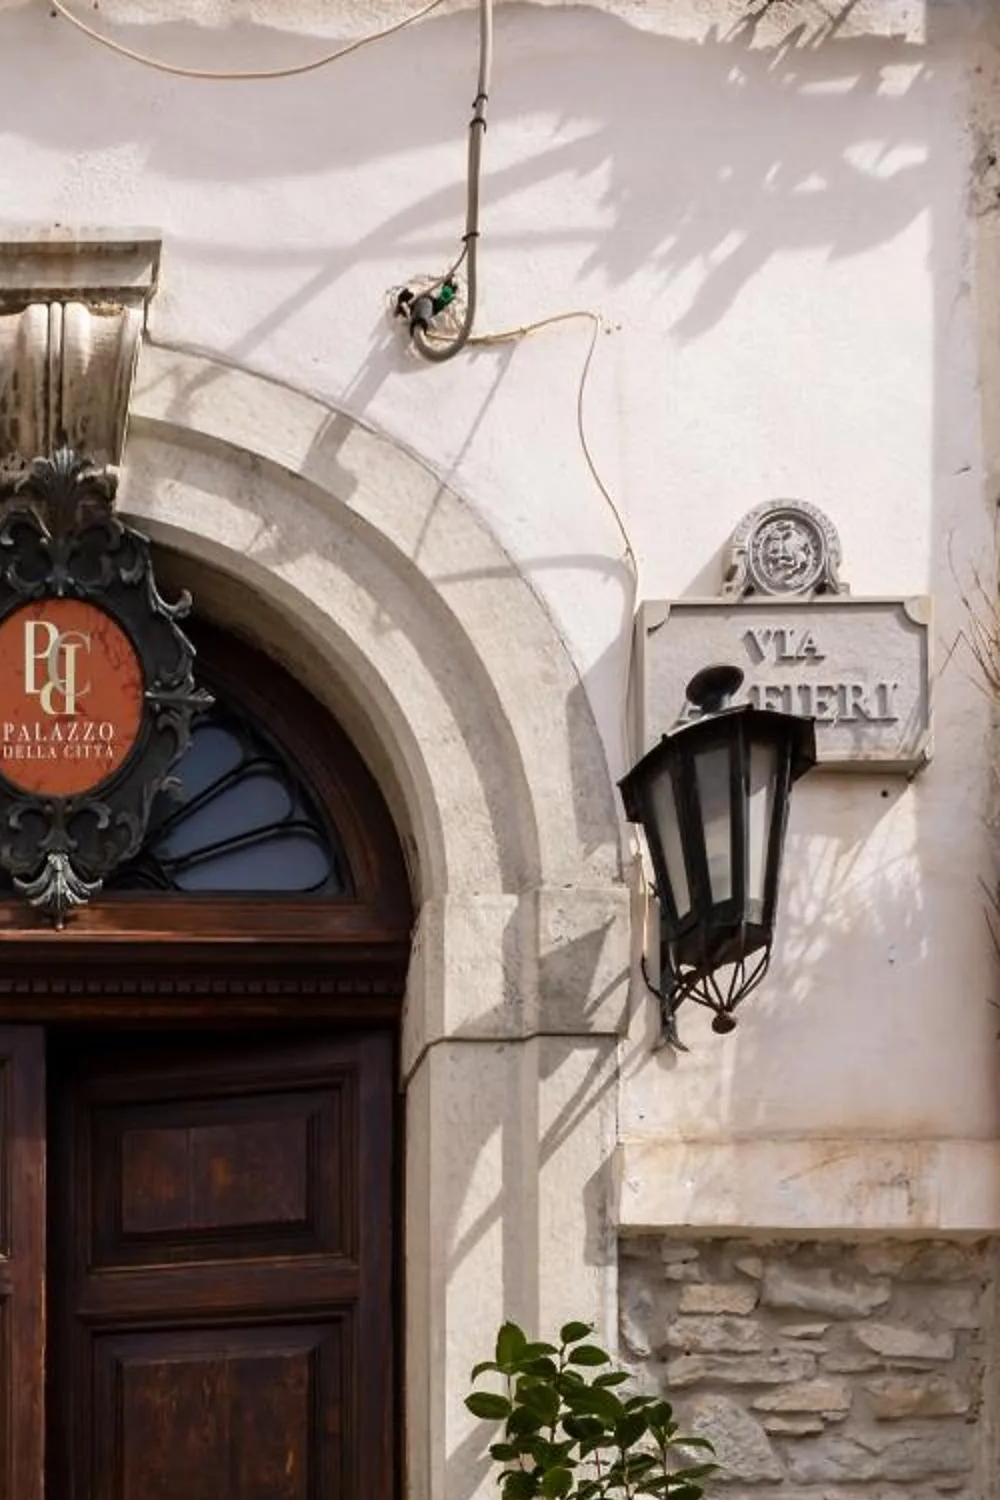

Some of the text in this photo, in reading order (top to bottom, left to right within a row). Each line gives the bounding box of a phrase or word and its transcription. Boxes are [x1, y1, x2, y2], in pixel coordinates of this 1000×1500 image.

[743, 629, 826, 664] VIA
[674, 683, 899, 723] FIERI
[2, 721, 114, 742] PALAZZO
[2, 744, 58, 760] DELLA
